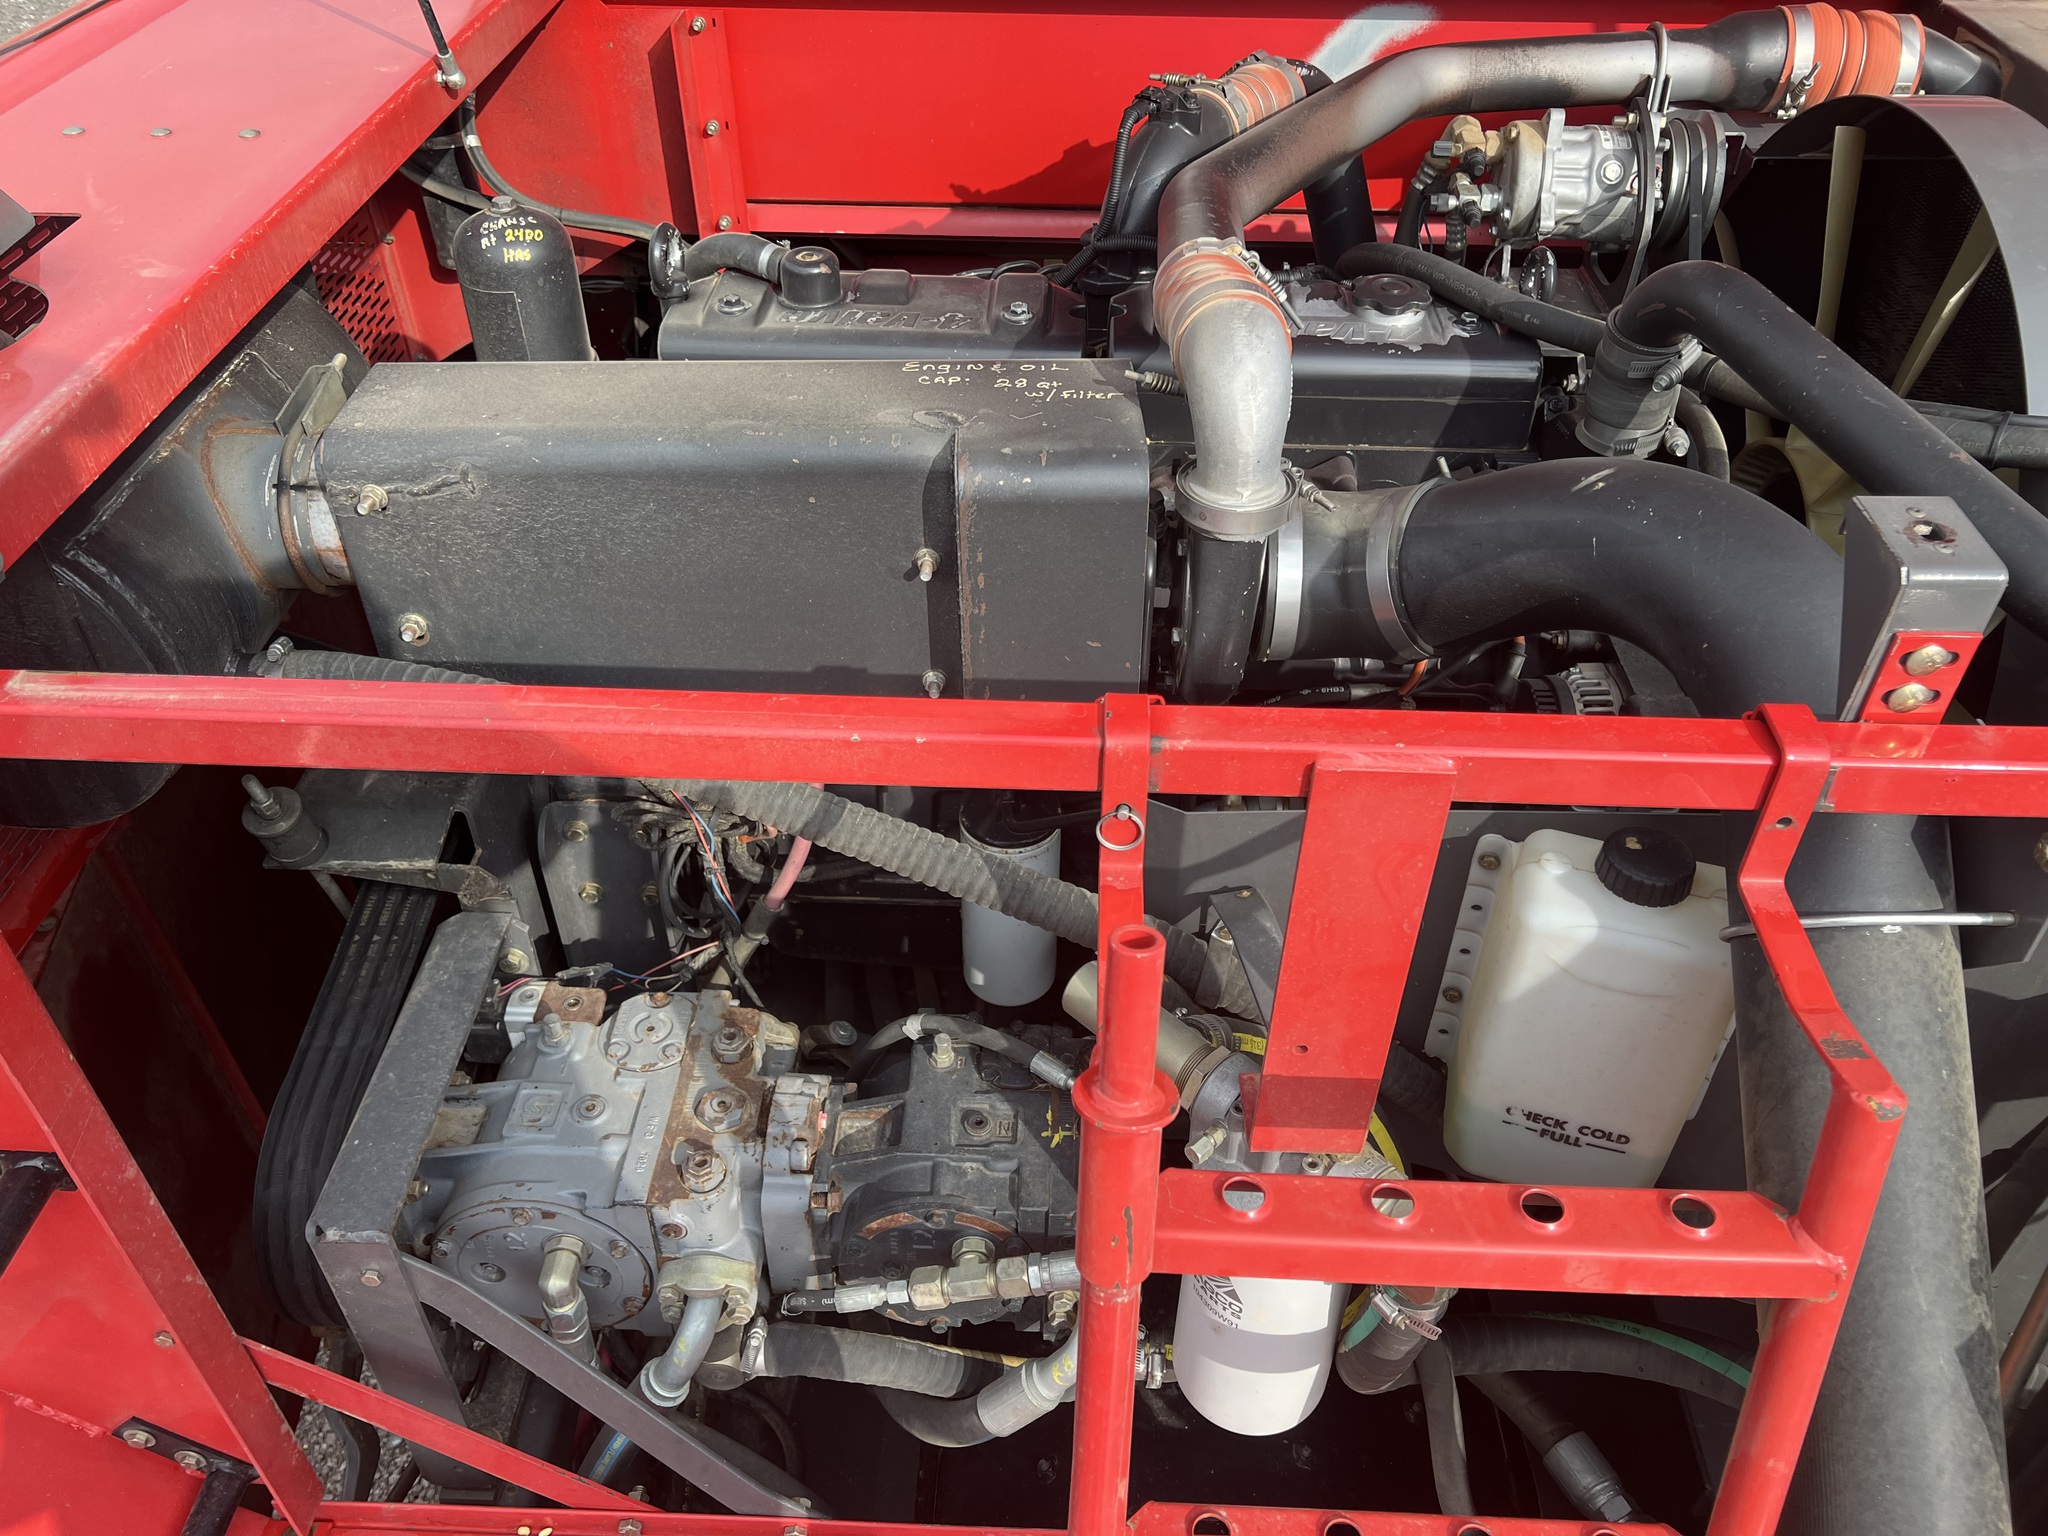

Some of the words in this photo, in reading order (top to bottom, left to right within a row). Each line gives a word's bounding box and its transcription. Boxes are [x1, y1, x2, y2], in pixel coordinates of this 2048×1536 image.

[994, 378, 1028, 388] 28
[1539, 1128, 1582, 1148] FULL
[1577, 1125, 1631, 1145] COLD
